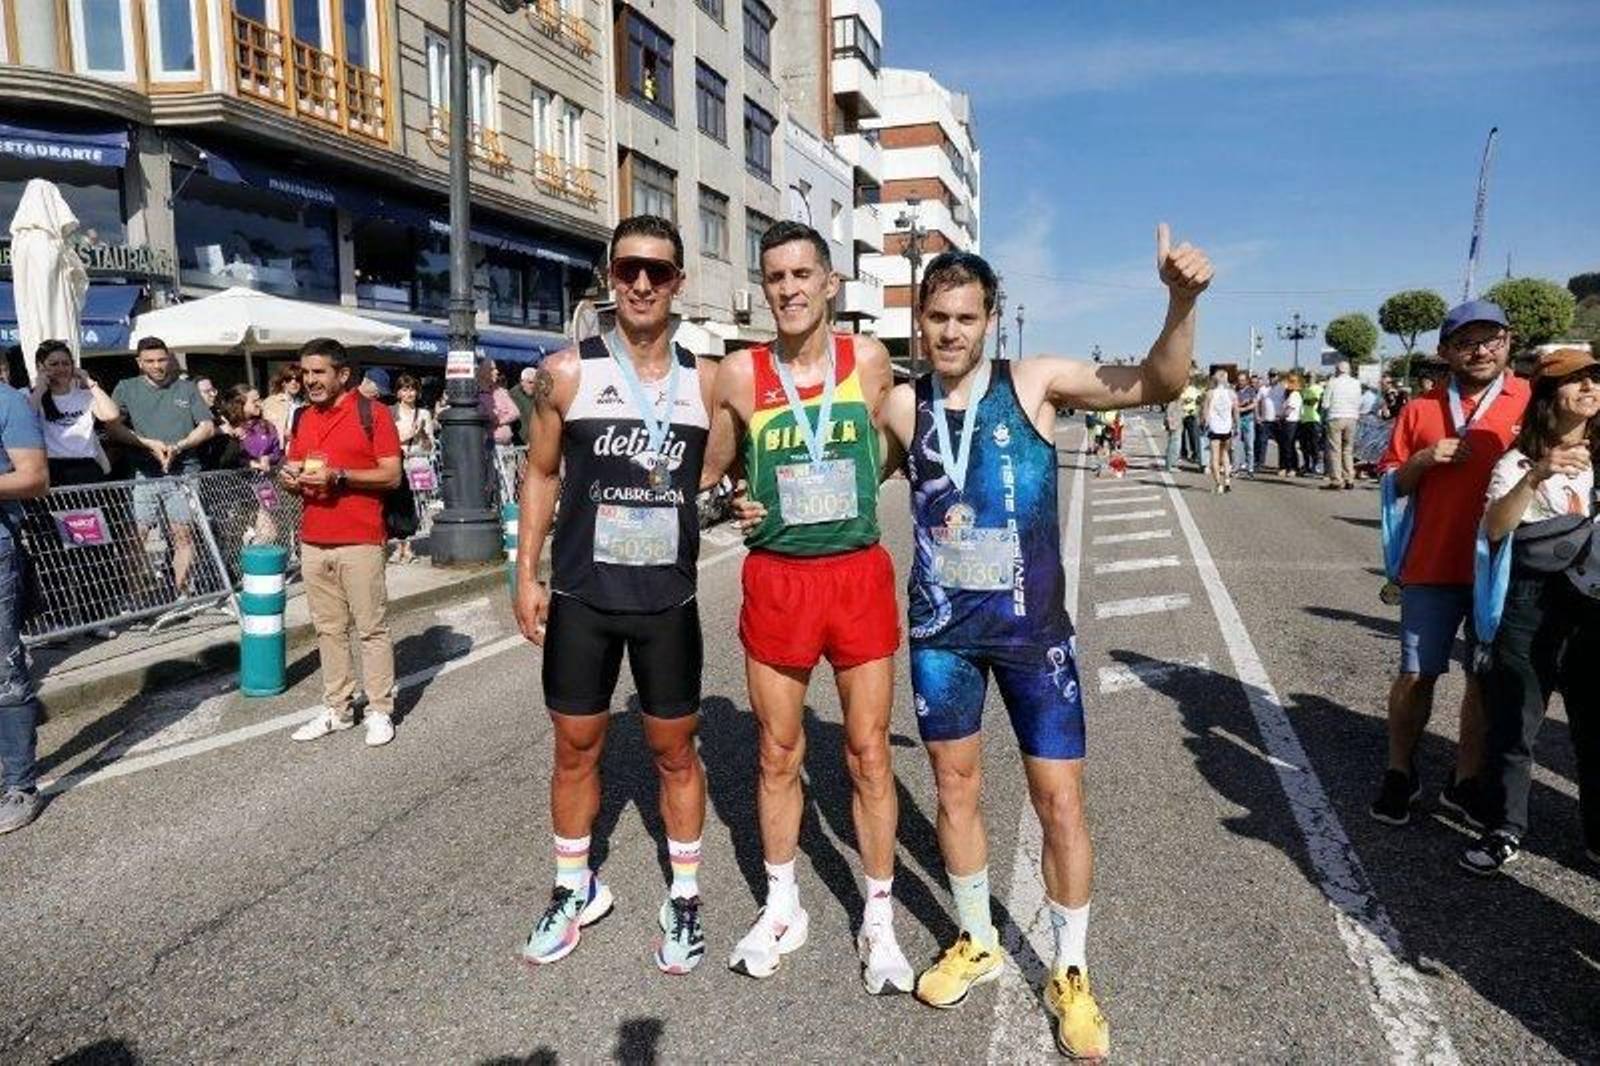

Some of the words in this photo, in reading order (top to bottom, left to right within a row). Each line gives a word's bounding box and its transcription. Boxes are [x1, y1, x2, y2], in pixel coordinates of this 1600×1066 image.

[0, 141, 102, 161] STAURANTE
[593, 425, 686, 461] deliia
[765, 420, 858, 451] BILA
